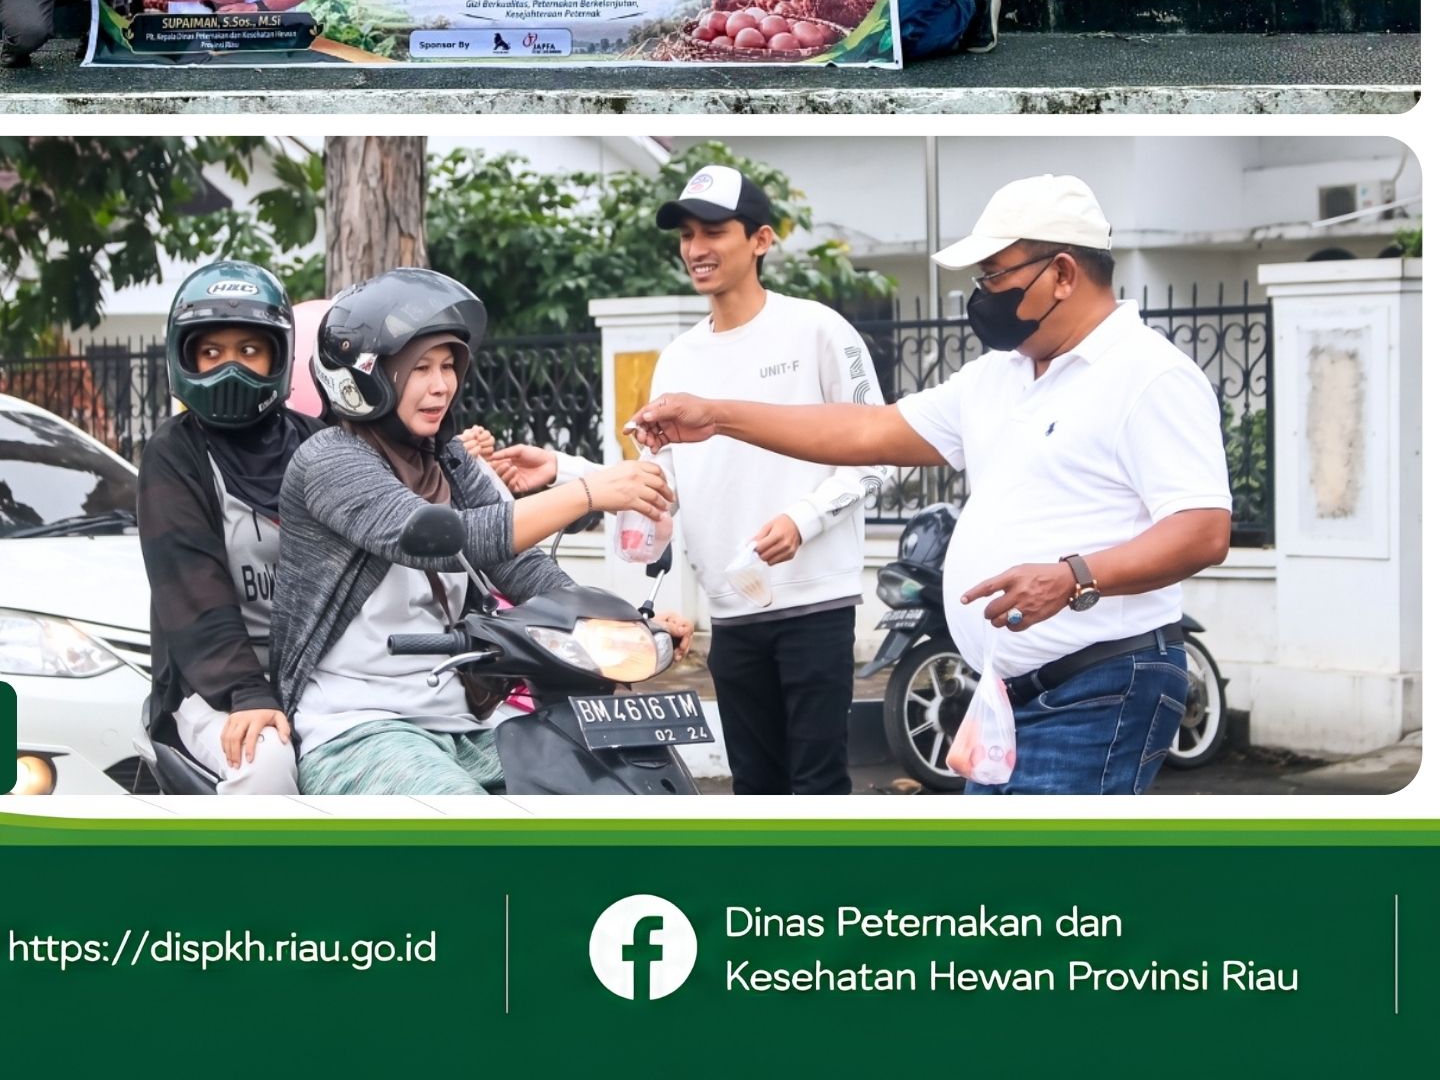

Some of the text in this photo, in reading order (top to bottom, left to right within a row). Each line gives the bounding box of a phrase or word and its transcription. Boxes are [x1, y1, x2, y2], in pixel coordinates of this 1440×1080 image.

[418, 41, 470, 51] Sponsor By
[576, 694, 698, 723] BM 4616 TM
[655, 726, 708, 741] 02 24
